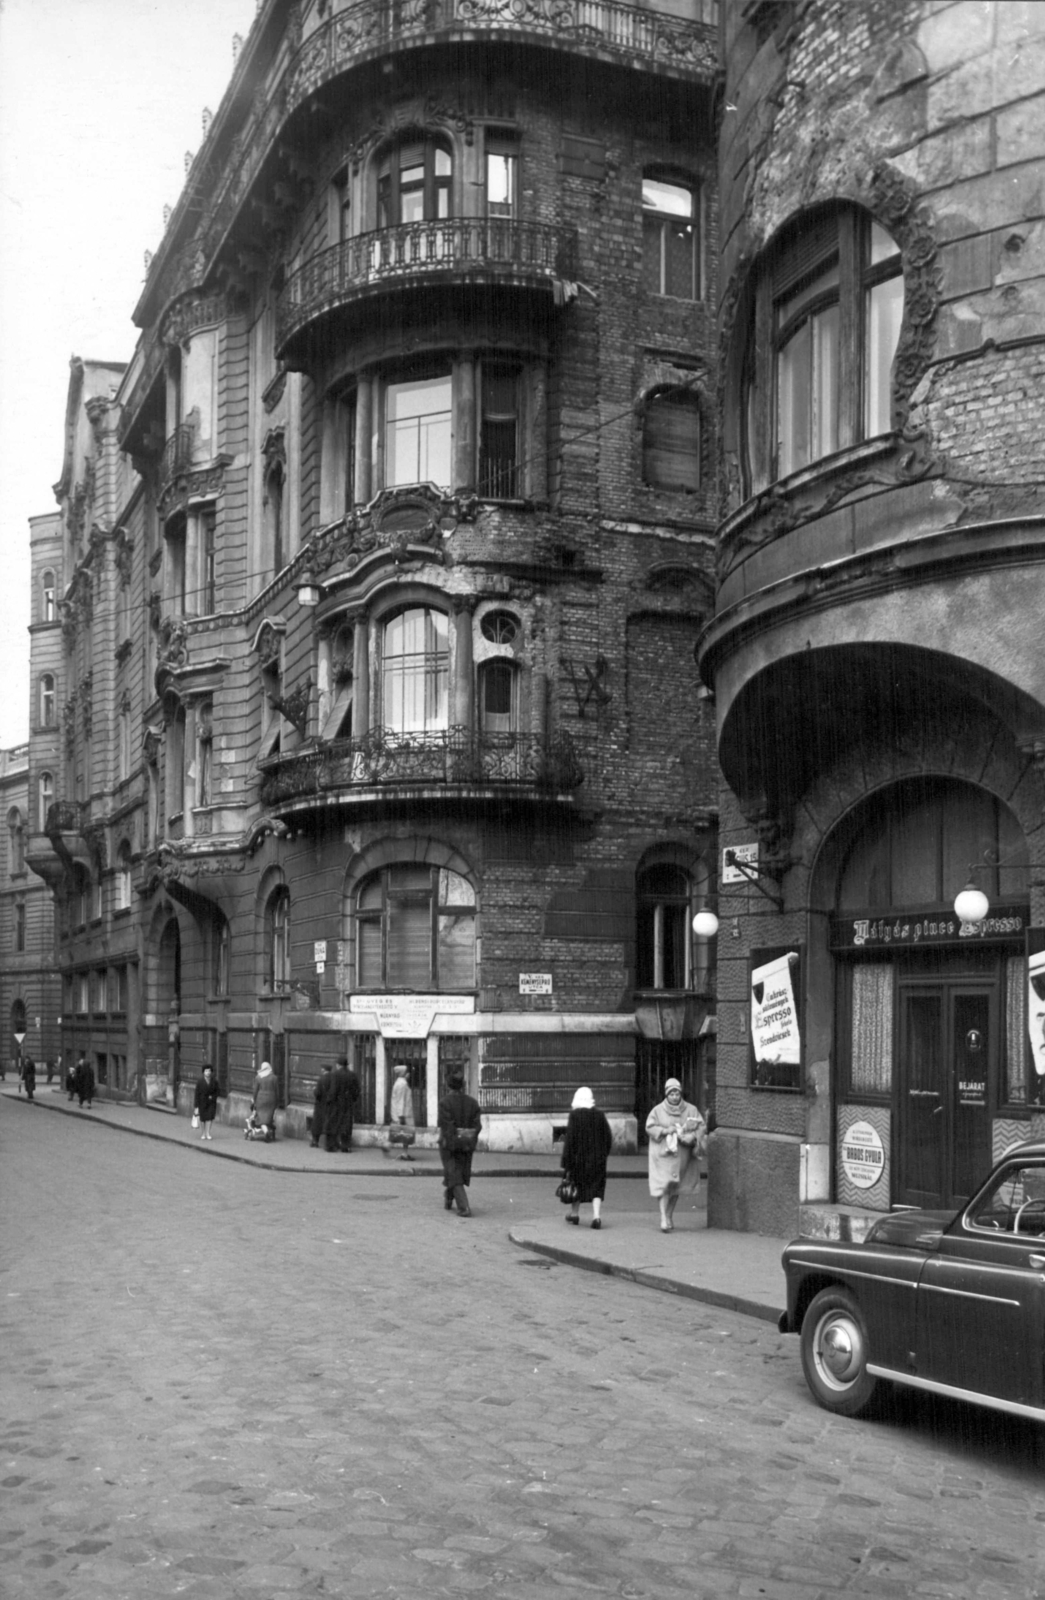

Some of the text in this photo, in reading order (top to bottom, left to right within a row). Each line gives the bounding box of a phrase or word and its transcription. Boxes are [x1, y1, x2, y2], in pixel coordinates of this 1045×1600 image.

[913, 919, 955, 942] pince
[959, 1080, 986, 1092] BEJÁRAT
[846, 1146, 882, 1164] BABOS GYULA
